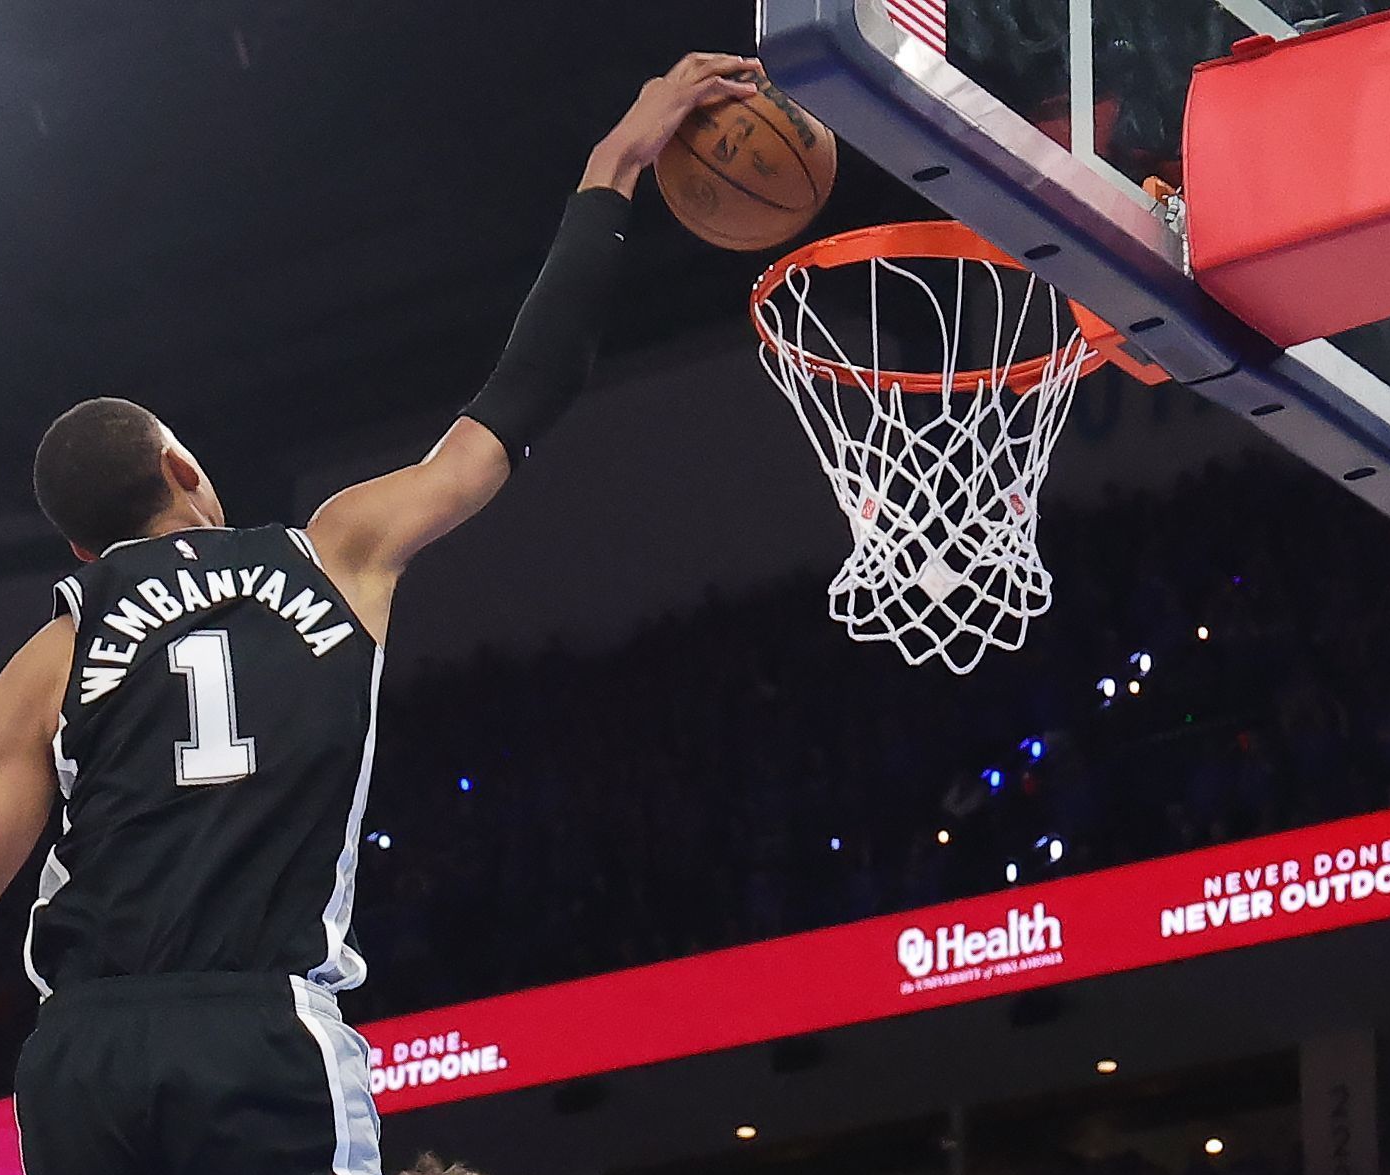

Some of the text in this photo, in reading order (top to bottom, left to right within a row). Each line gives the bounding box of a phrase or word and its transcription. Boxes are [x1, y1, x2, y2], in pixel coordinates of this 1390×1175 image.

[79, 564, 354, 704] WEMBANYAMA
[167, 629, 257, 787] 1
[1203, 860, 1300, 899] NEVER
[935, 902, 1063, 972] Health
[1160, 889, 1274, 938] NEVER
[370, 1044, 508, 1095] OUTDONE.
[392, 1030, 470, 1063] DONE.
